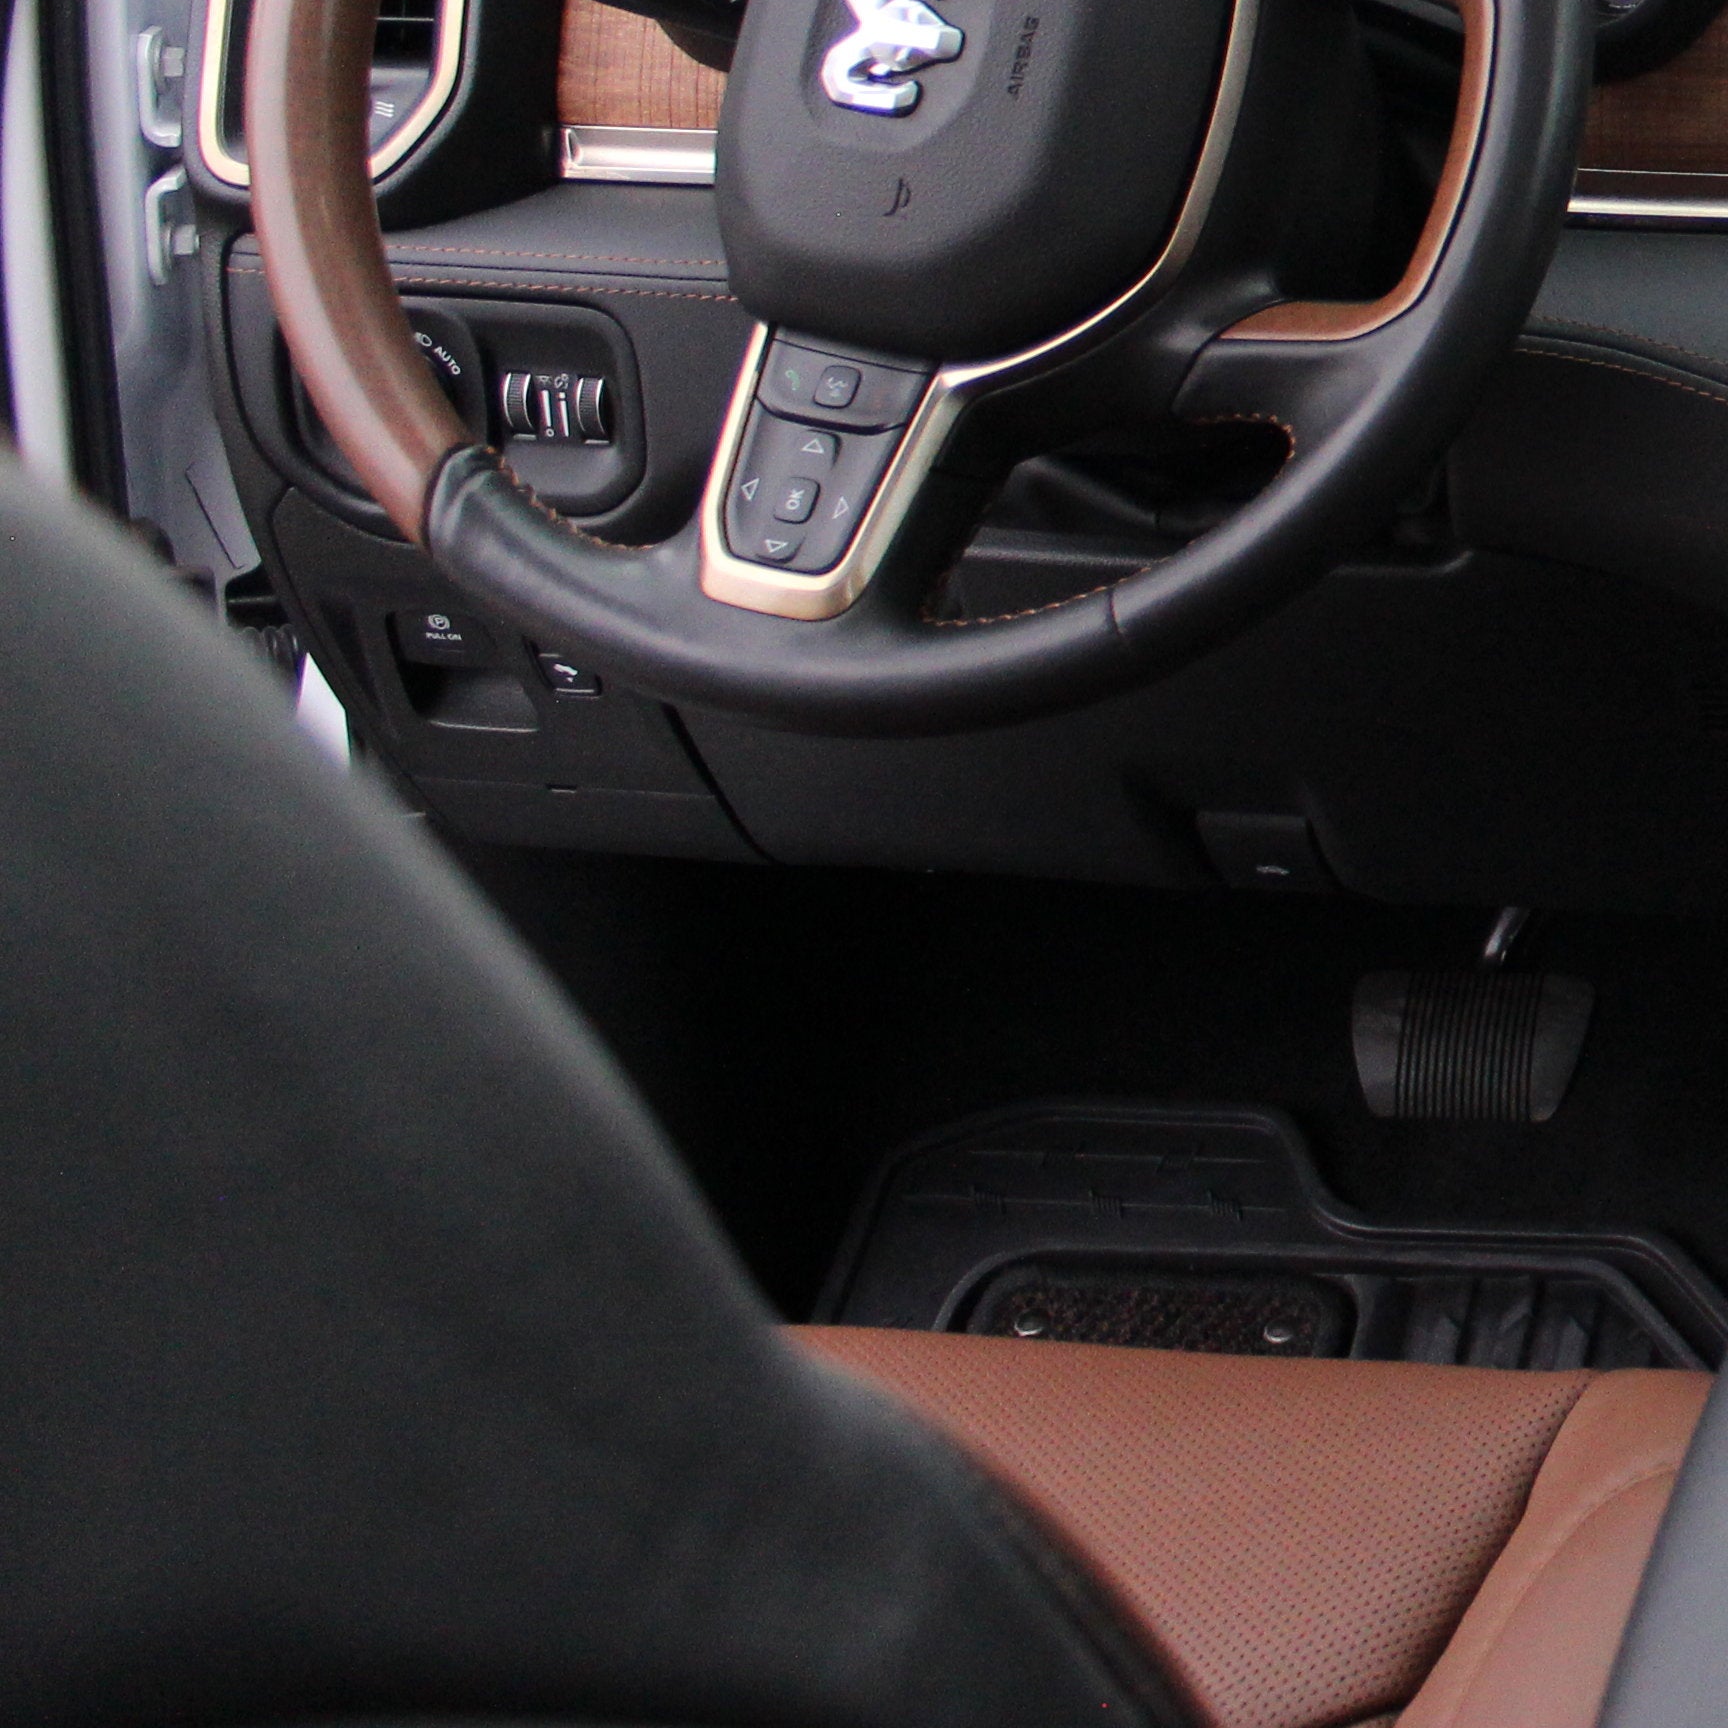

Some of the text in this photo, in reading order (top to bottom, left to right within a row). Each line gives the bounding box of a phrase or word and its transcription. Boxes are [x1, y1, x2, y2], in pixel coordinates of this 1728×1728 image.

[1007, 16, 1040, 100] AIRBAG
[434, 346, 462, 376] AUTO
[785, 488, 806, 510] OK
